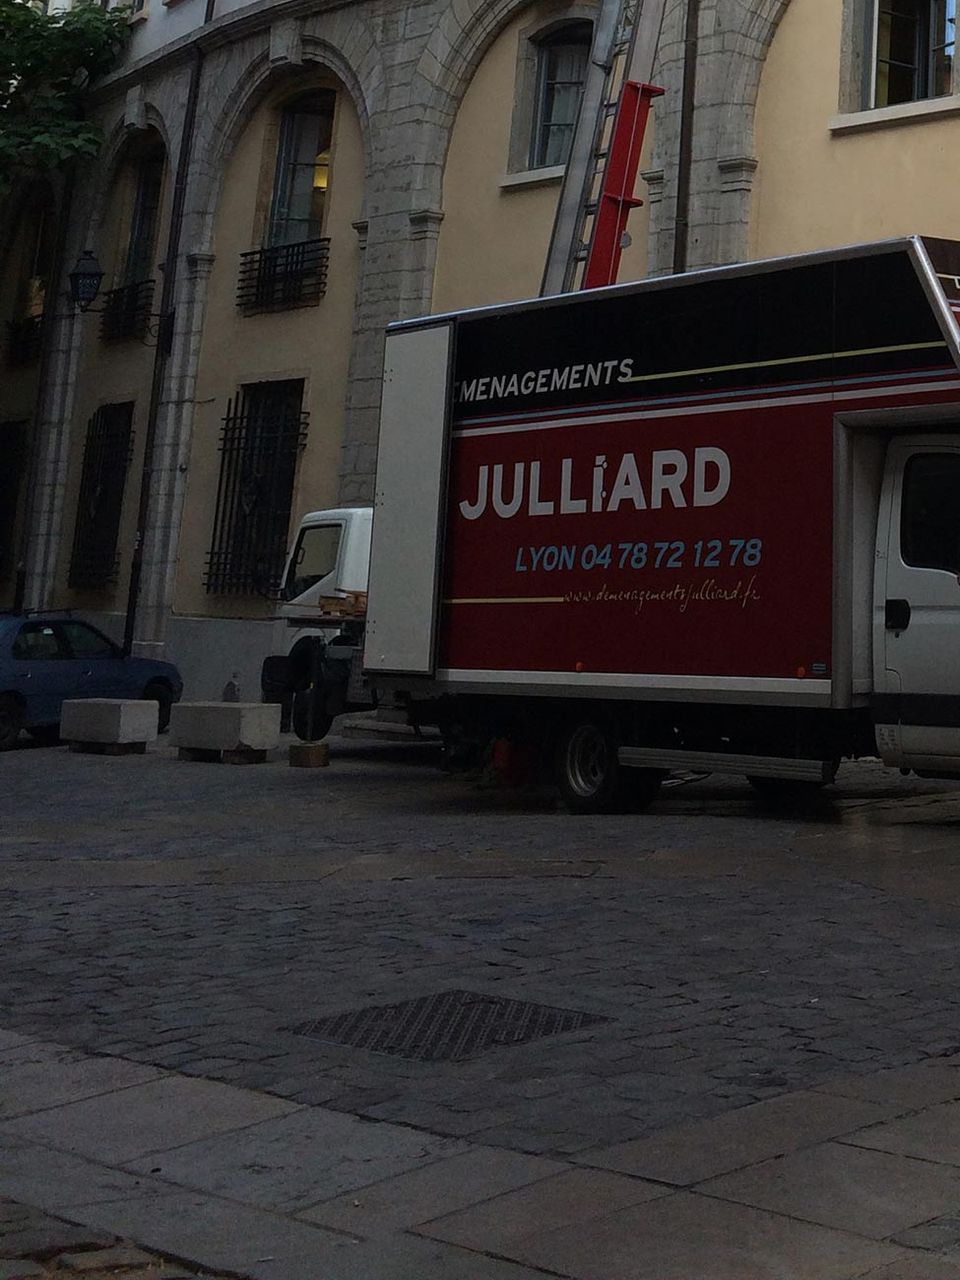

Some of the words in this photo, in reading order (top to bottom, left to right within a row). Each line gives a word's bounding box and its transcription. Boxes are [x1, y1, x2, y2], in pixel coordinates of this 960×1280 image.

[515, 544, 576, 573] LYON
[579, 544, 613, 572] 04
[617, 542, 648, 570] 78
[653, 541, 686, 569] 72
[693, 539, 724, 568] 12
[728, 538, 763, 568] 78
